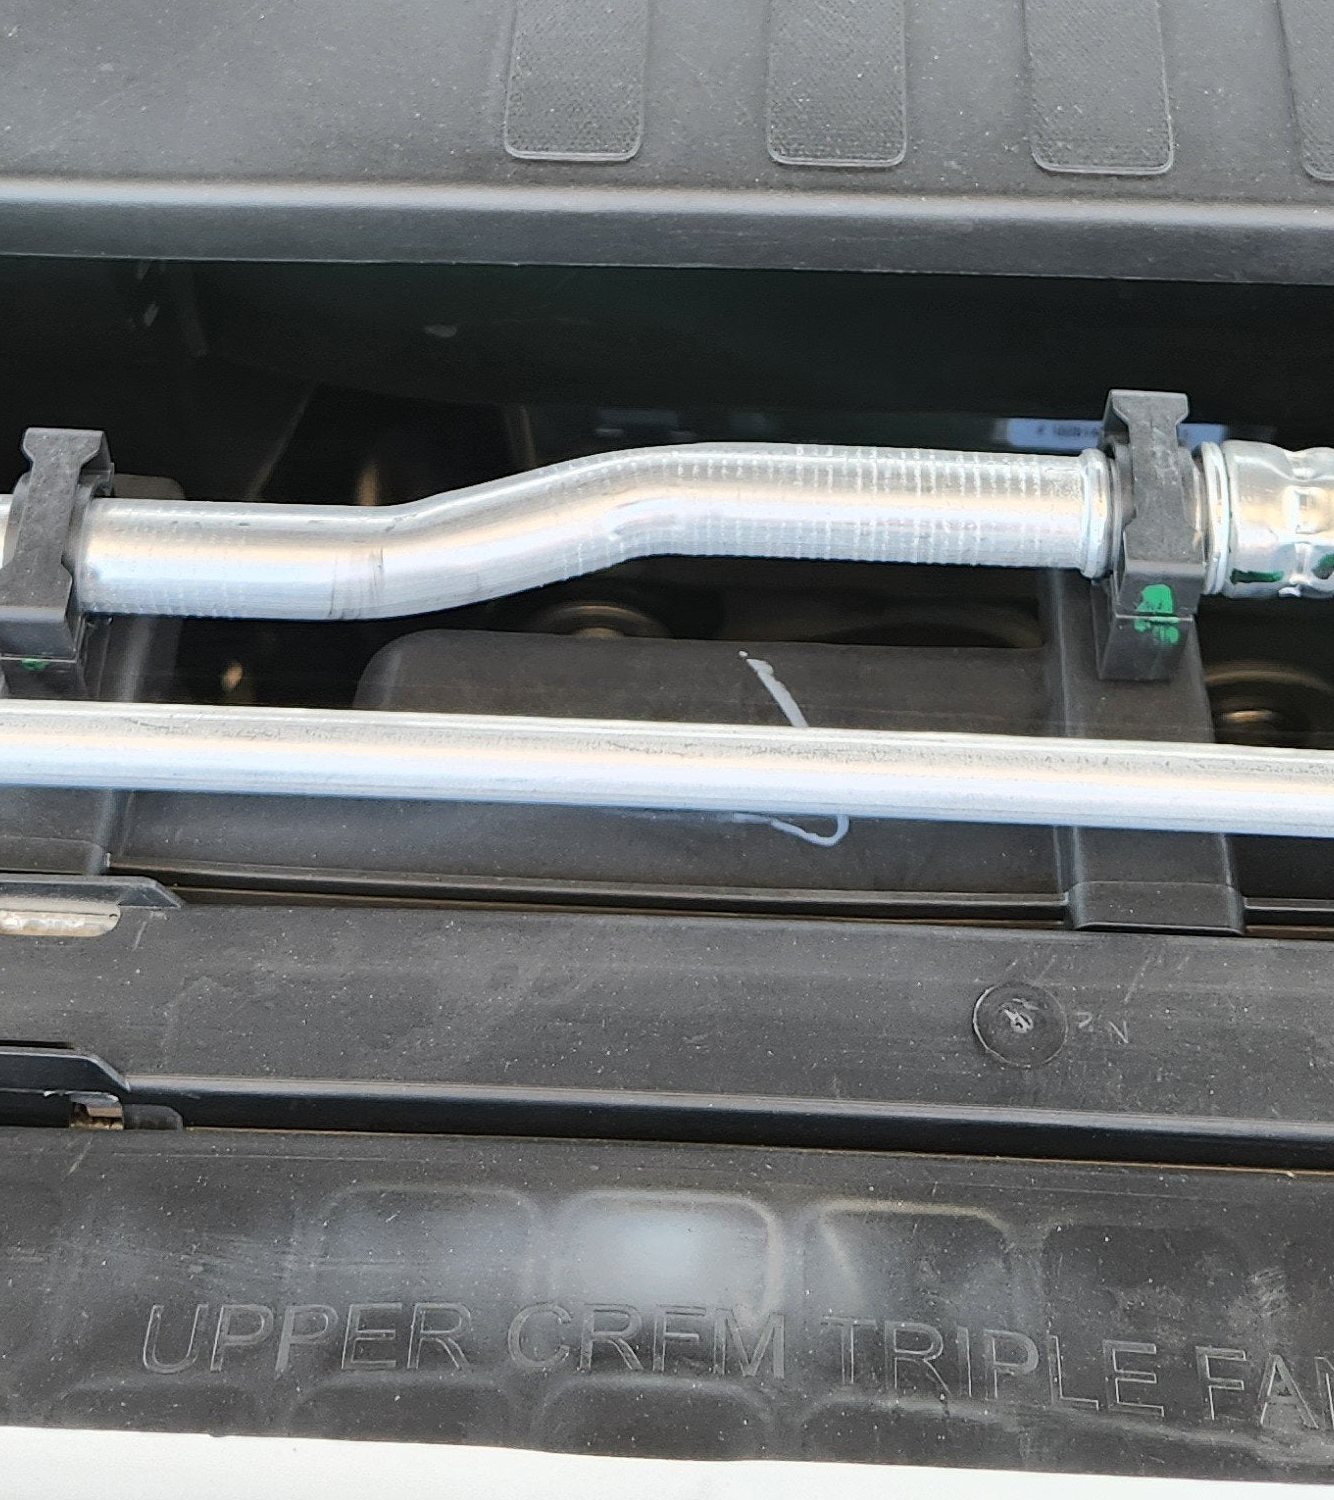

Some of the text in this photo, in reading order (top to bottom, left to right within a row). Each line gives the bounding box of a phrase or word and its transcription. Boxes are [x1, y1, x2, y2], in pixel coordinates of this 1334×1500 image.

[142, 1302, 472, 1377] UPPER
[507, 1301, 787, 1380] CRFM
[820, 1311, 1166, 1418] TRIPLE
